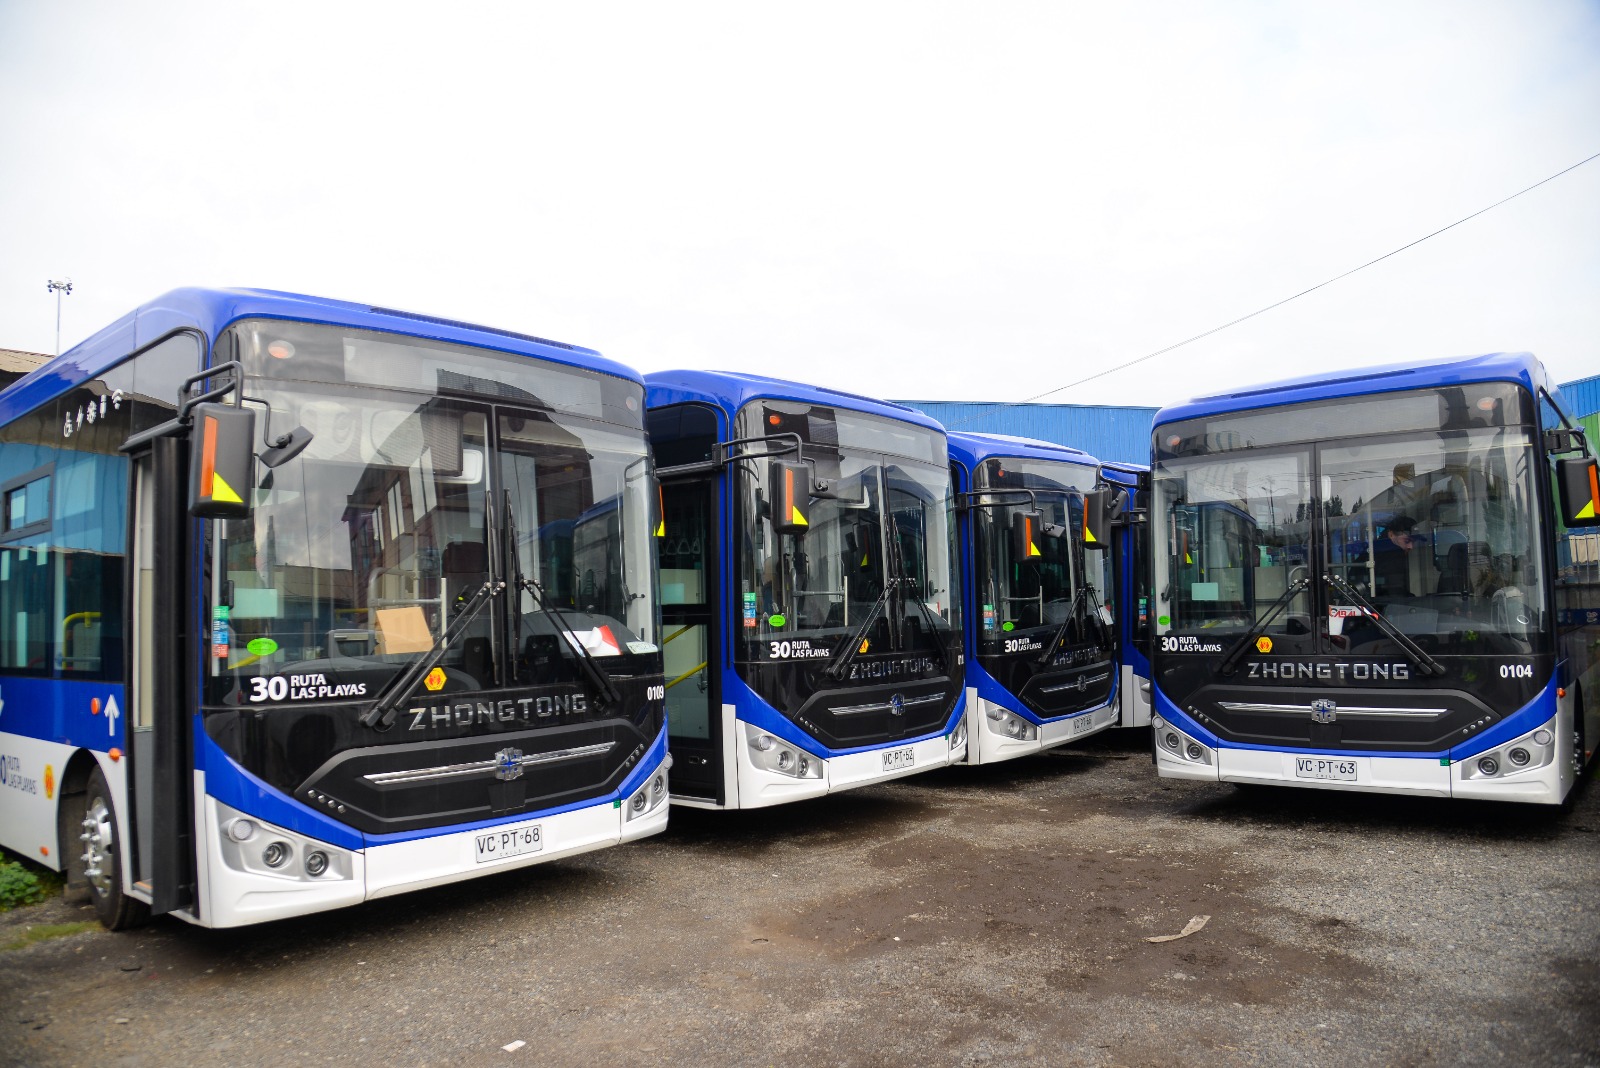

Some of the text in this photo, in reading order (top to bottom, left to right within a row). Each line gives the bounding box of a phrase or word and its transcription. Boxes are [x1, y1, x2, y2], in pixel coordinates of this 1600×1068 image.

[791, 641, 810, 649] RUTA
[1004, 639, 1019, 653] 30
[1161, 636, 1178, 652] 30
[1179, 636, 1198, 644] RUTA
[769, 641, 791, 659] 30
[791, 648, 830, 658] LAS PLAYAS
[1180, 644, 1222, 652] LAS PLAYAS
[849, 657, 933, 679] ZHONGTONG
[1247, 662, 1409, 680] ZHONGTONG
[1499, 664, 1533, 679] 0104
[290, 673, 327, 687] RUTA
[249, 676, 289, 702] 30
[290, 683, 367, 700] LAS PLAYAS
[408, 693, 588, 732] ZHONGTONG
